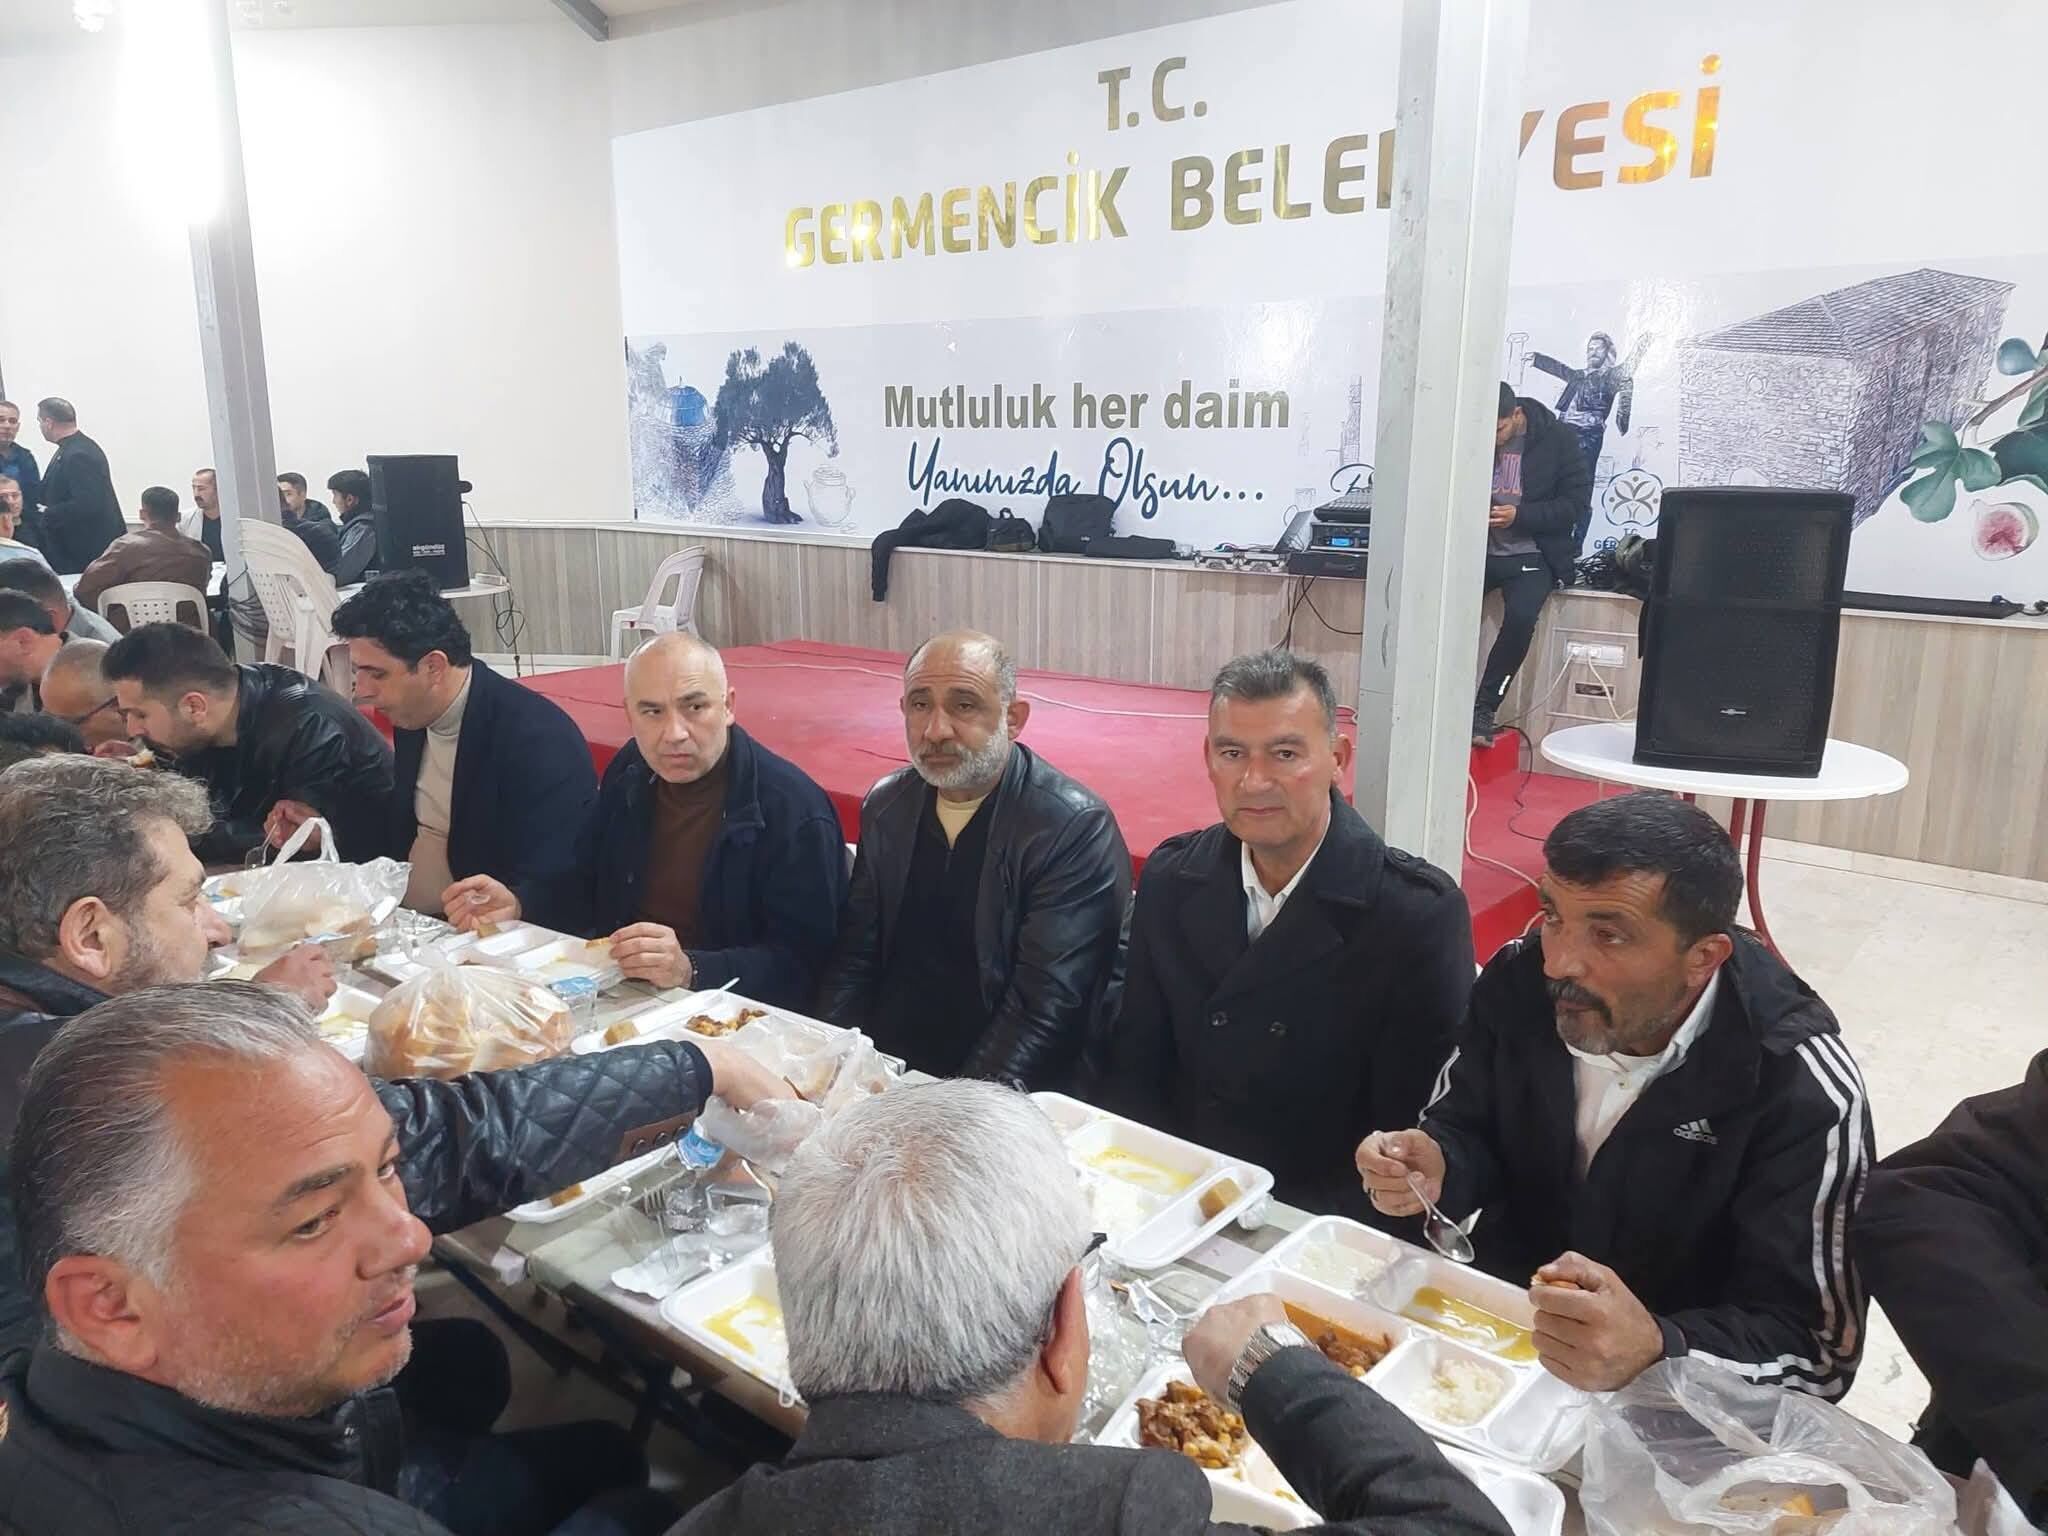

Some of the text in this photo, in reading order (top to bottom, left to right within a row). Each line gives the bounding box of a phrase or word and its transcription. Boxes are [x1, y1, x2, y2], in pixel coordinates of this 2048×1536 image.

[1098, 56, 1208, 131] T.C.
[785, 53, 1721, 268] GERMENCİK BELEESİ
[884, 378, 1290, 429] Mutluluk her daim
[1673, 1127, 1718, 1145] adidas
